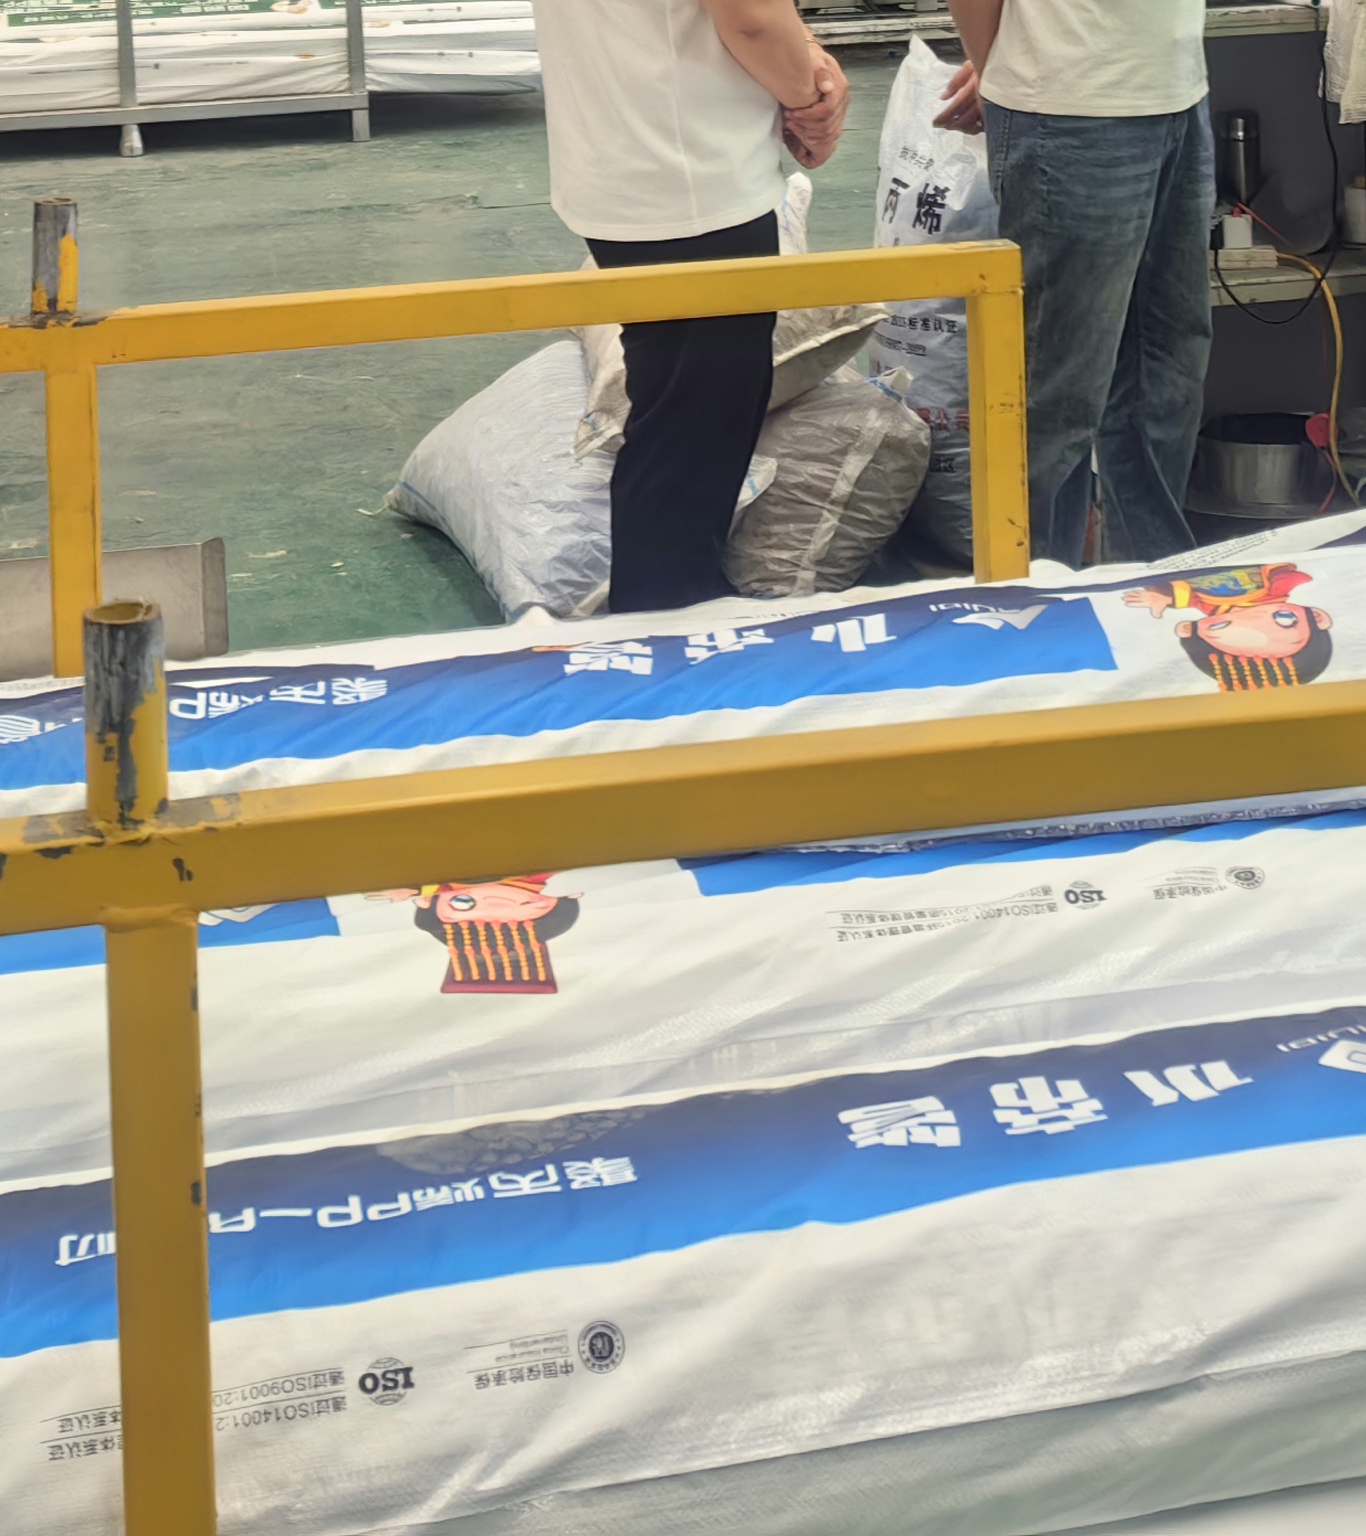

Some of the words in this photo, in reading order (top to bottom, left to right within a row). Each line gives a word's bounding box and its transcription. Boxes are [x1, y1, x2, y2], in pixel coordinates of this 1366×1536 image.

[1064, 888, 1107, 905] ISO
[358, 1365, 415, 1395] ISO
[473, 1358, 575, 1391] 中国保险承保
